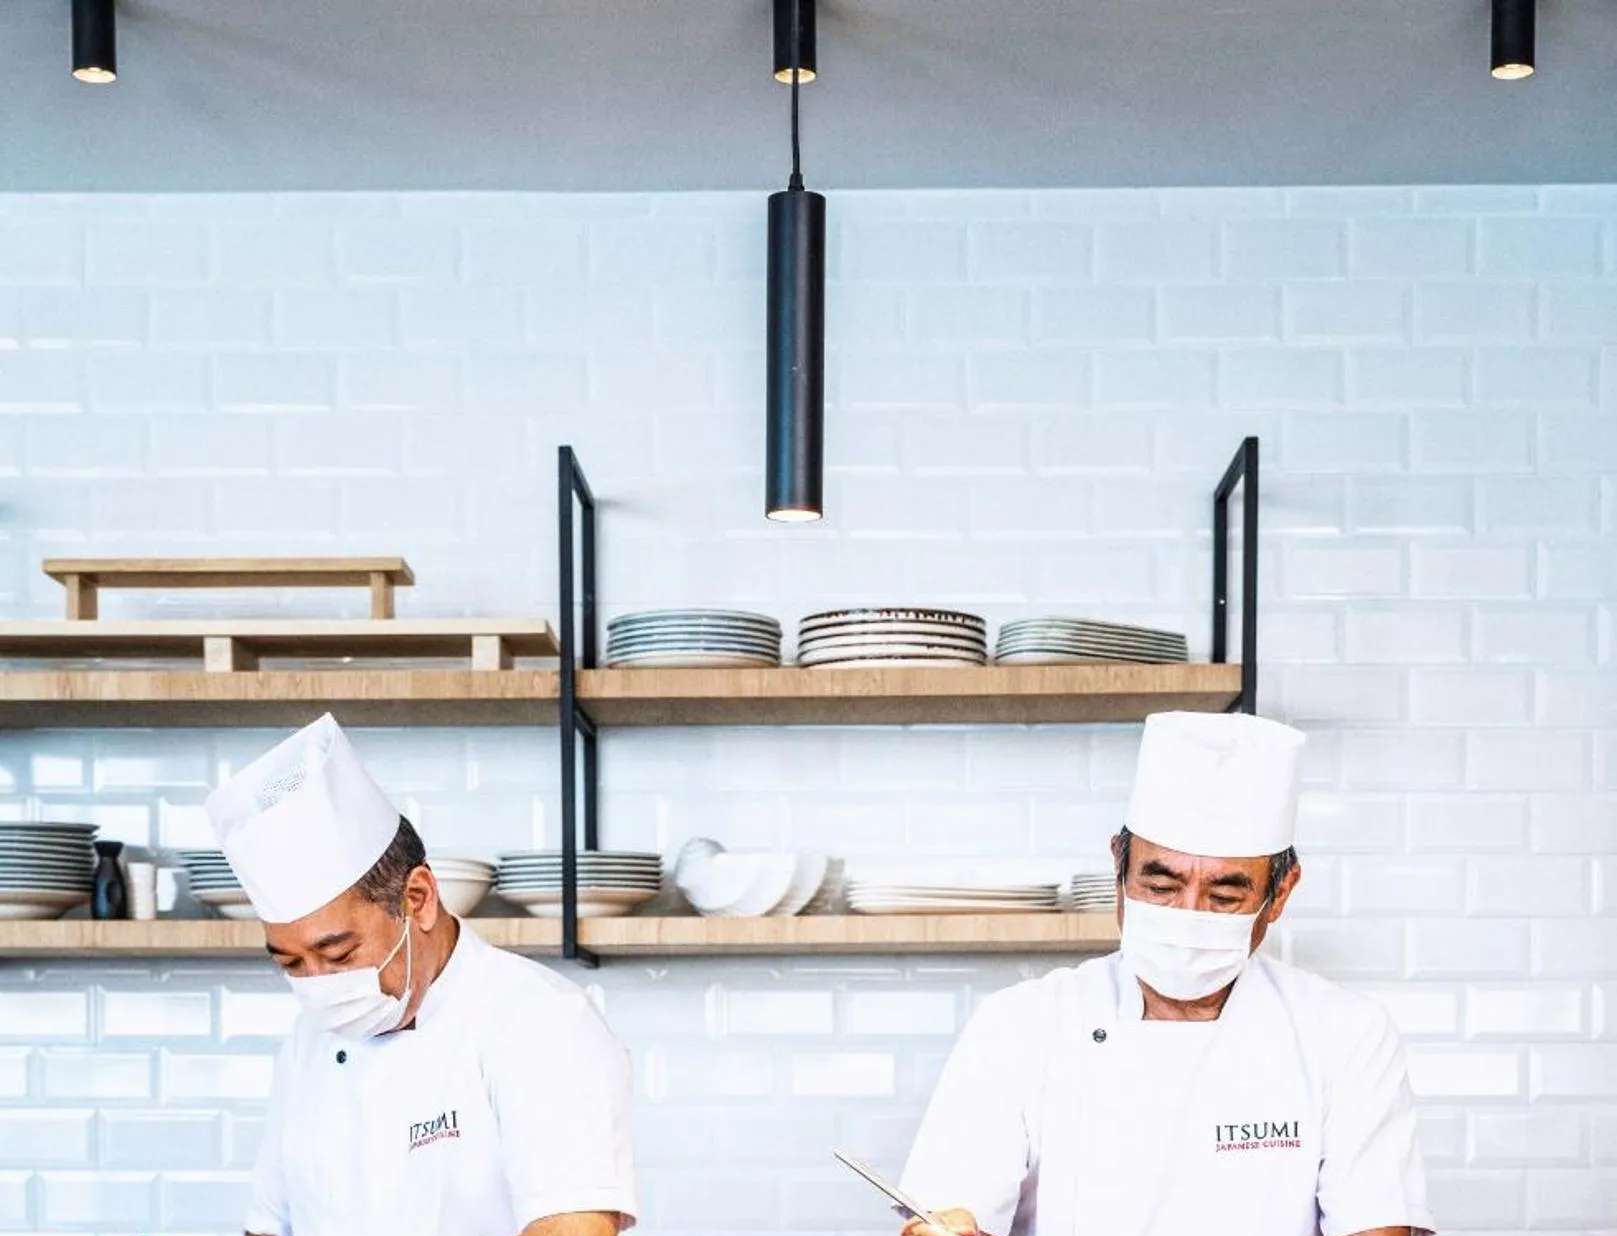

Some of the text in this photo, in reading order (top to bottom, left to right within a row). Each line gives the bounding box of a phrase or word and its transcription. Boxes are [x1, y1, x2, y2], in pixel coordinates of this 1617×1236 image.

[409, 1110, 457, 1142] ITSUMI
[1216, 1121, 1298, 1141] ITSUMI
[1215, 1140, 1301, 1152] JAPANESE CUISINE
